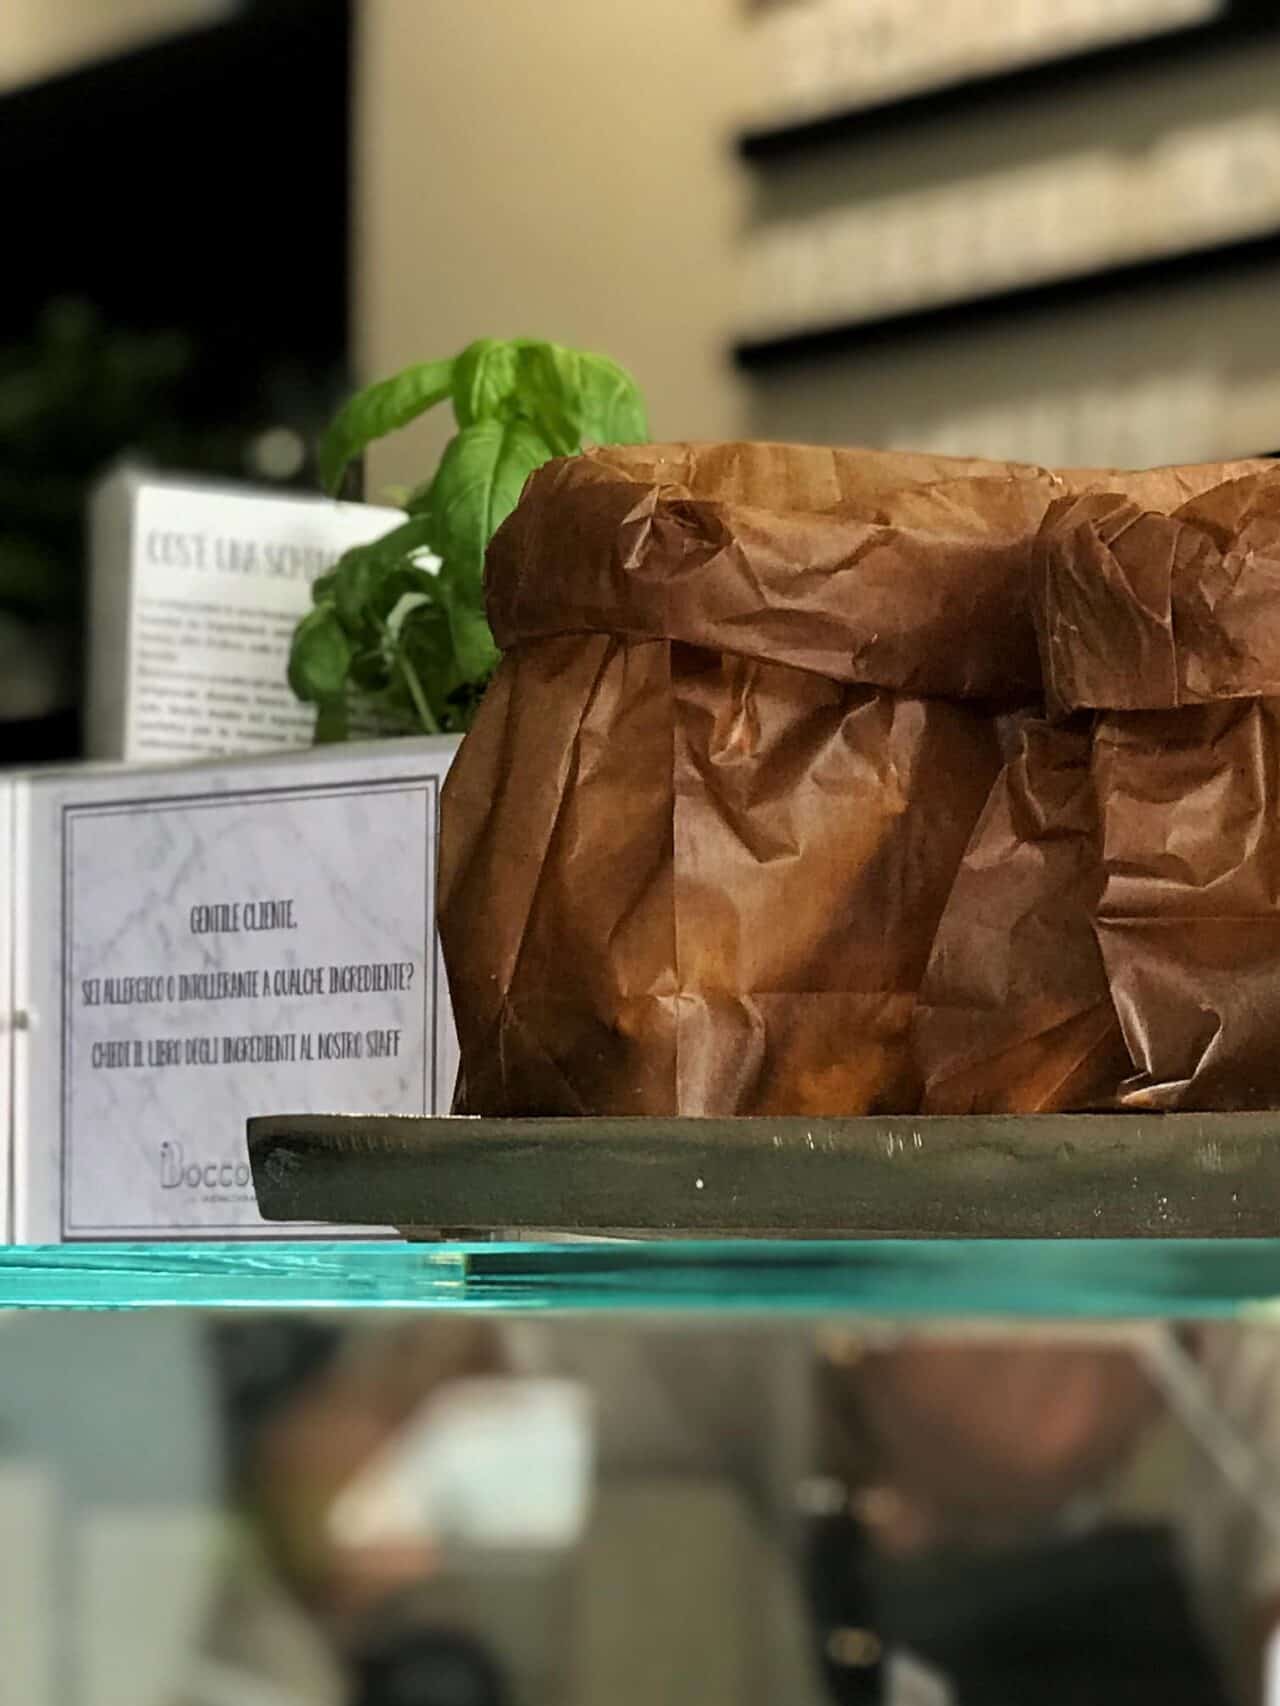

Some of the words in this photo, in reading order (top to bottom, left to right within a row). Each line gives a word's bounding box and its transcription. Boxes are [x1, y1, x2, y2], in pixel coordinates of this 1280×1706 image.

[190, 904, 240, 934] GENTILE
[167, 975, 176, 1003] O
[262, 970, 272, 998] A
[274, 967, 325, 997] QUALCHE
[328, 962, 415, 994] INGREDIENTE?
[185, 1037, 219, 1065] DEGLI
[222, 1034, 297, 1065] INGREDIENTI
[300, 1033, 314, 1061] AL
[318, 1031, 363, 1060] NOSTRO
[366, 1029, 402, 1058] STAFF
